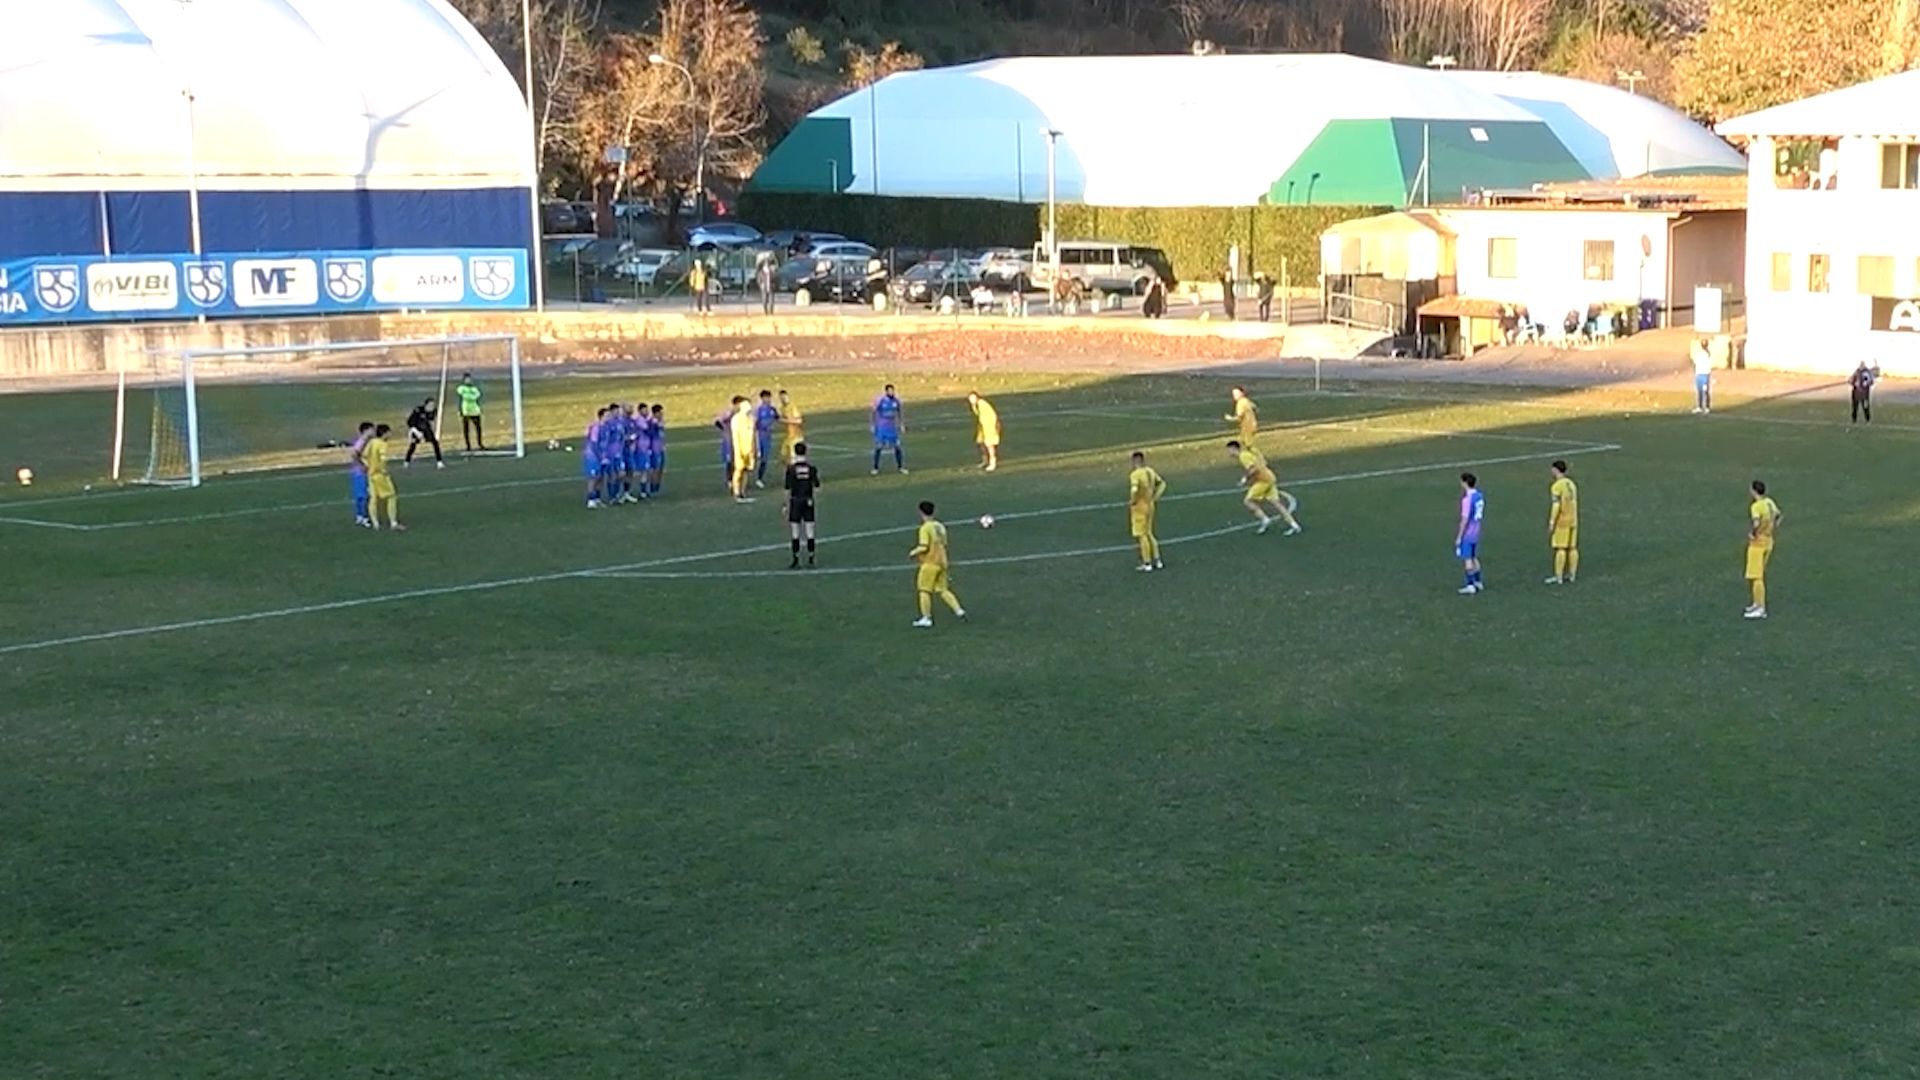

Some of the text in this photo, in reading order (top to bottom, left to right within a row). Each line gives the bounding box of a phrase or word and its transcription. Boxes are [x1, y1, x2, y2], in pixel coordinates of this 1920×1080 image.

[115, 275, 169, 290] VIBI
[251, 266, 297, 295] MF
[0, 293, 28, 313] IA
